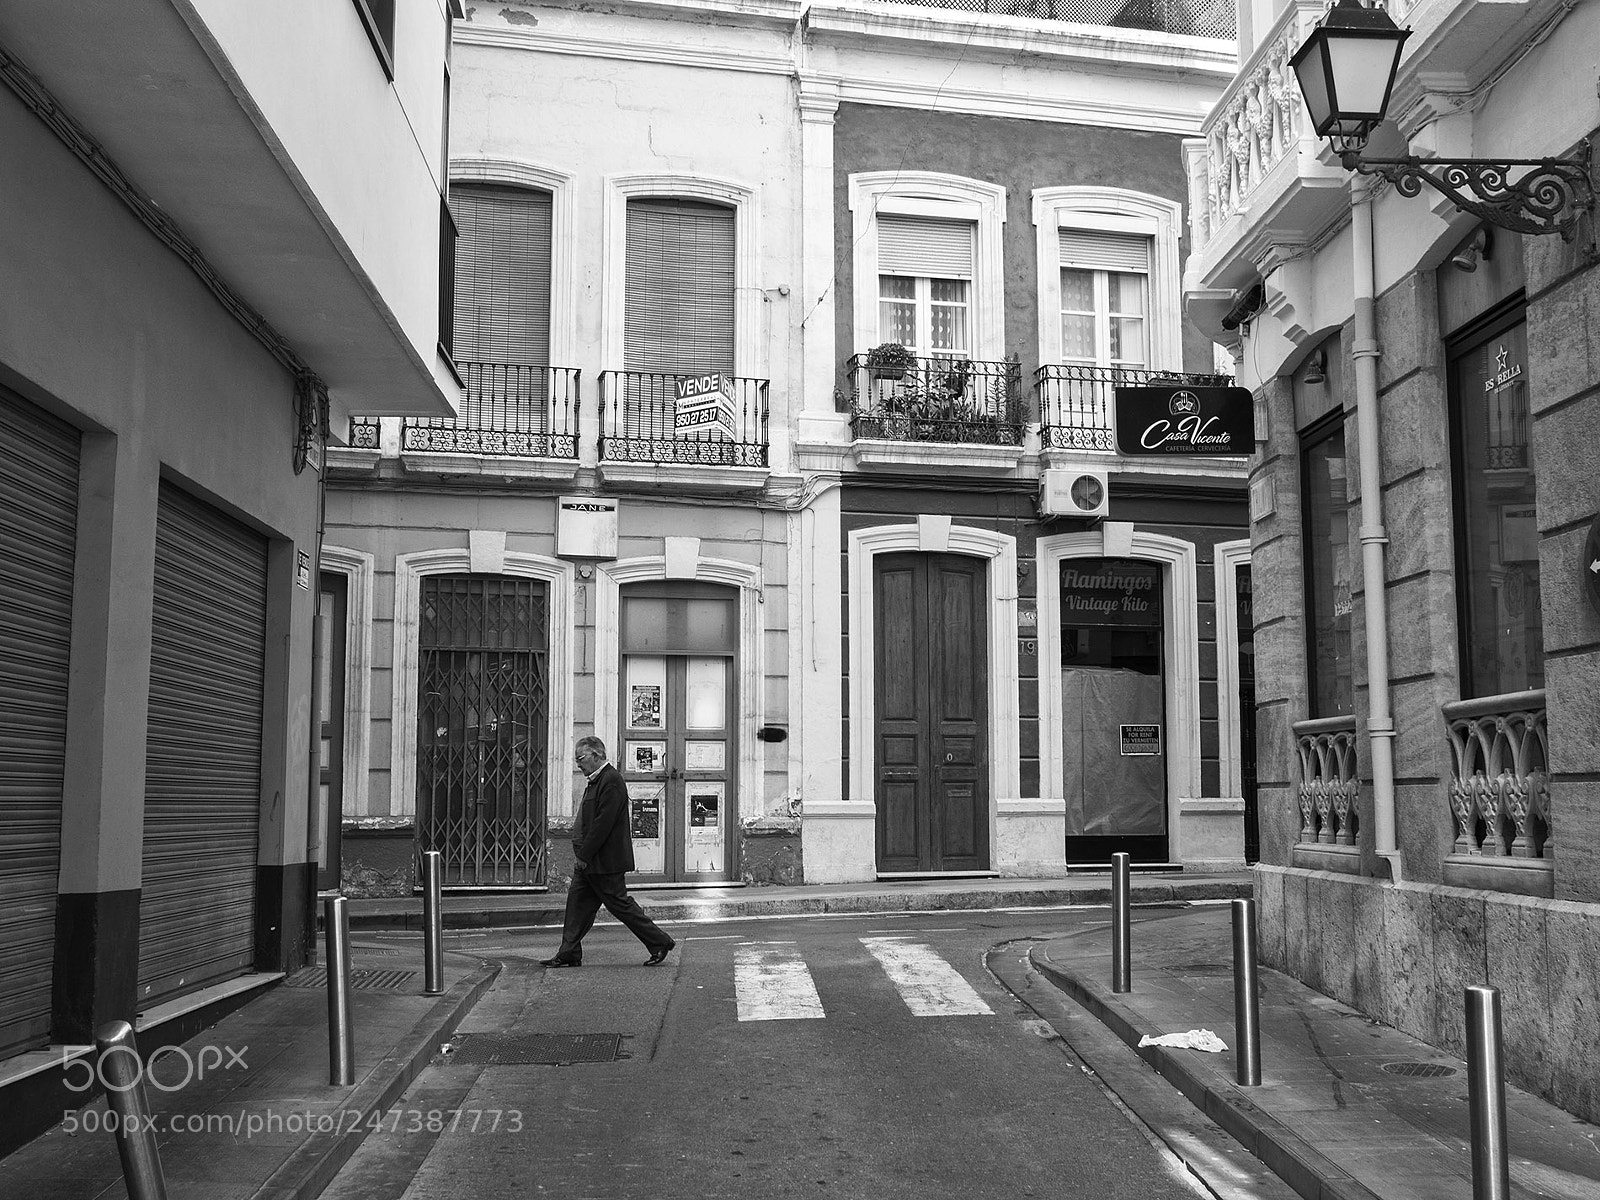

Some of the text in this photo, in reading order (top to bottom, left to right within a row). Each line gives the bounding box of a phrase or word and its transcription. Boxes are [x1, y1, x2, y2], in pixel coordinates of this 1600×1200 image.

[678, 374, 719, 397] VENDE
[675, 413, 690, 427] 950
[690, 411, 700, 425] 27
[700, 409, 709, 423] 25
[709, 407, 717, 421] 17
[1140, 415, 1231, 449] Casa Vicente
[1197, 444, 1231, 452] CERVECERÍA
[1062, 569, 1152, 595] Flamingos
[1065, 595, 1150, 614] Vintage Kilo
[1020, 641, 1035, 655] 19
